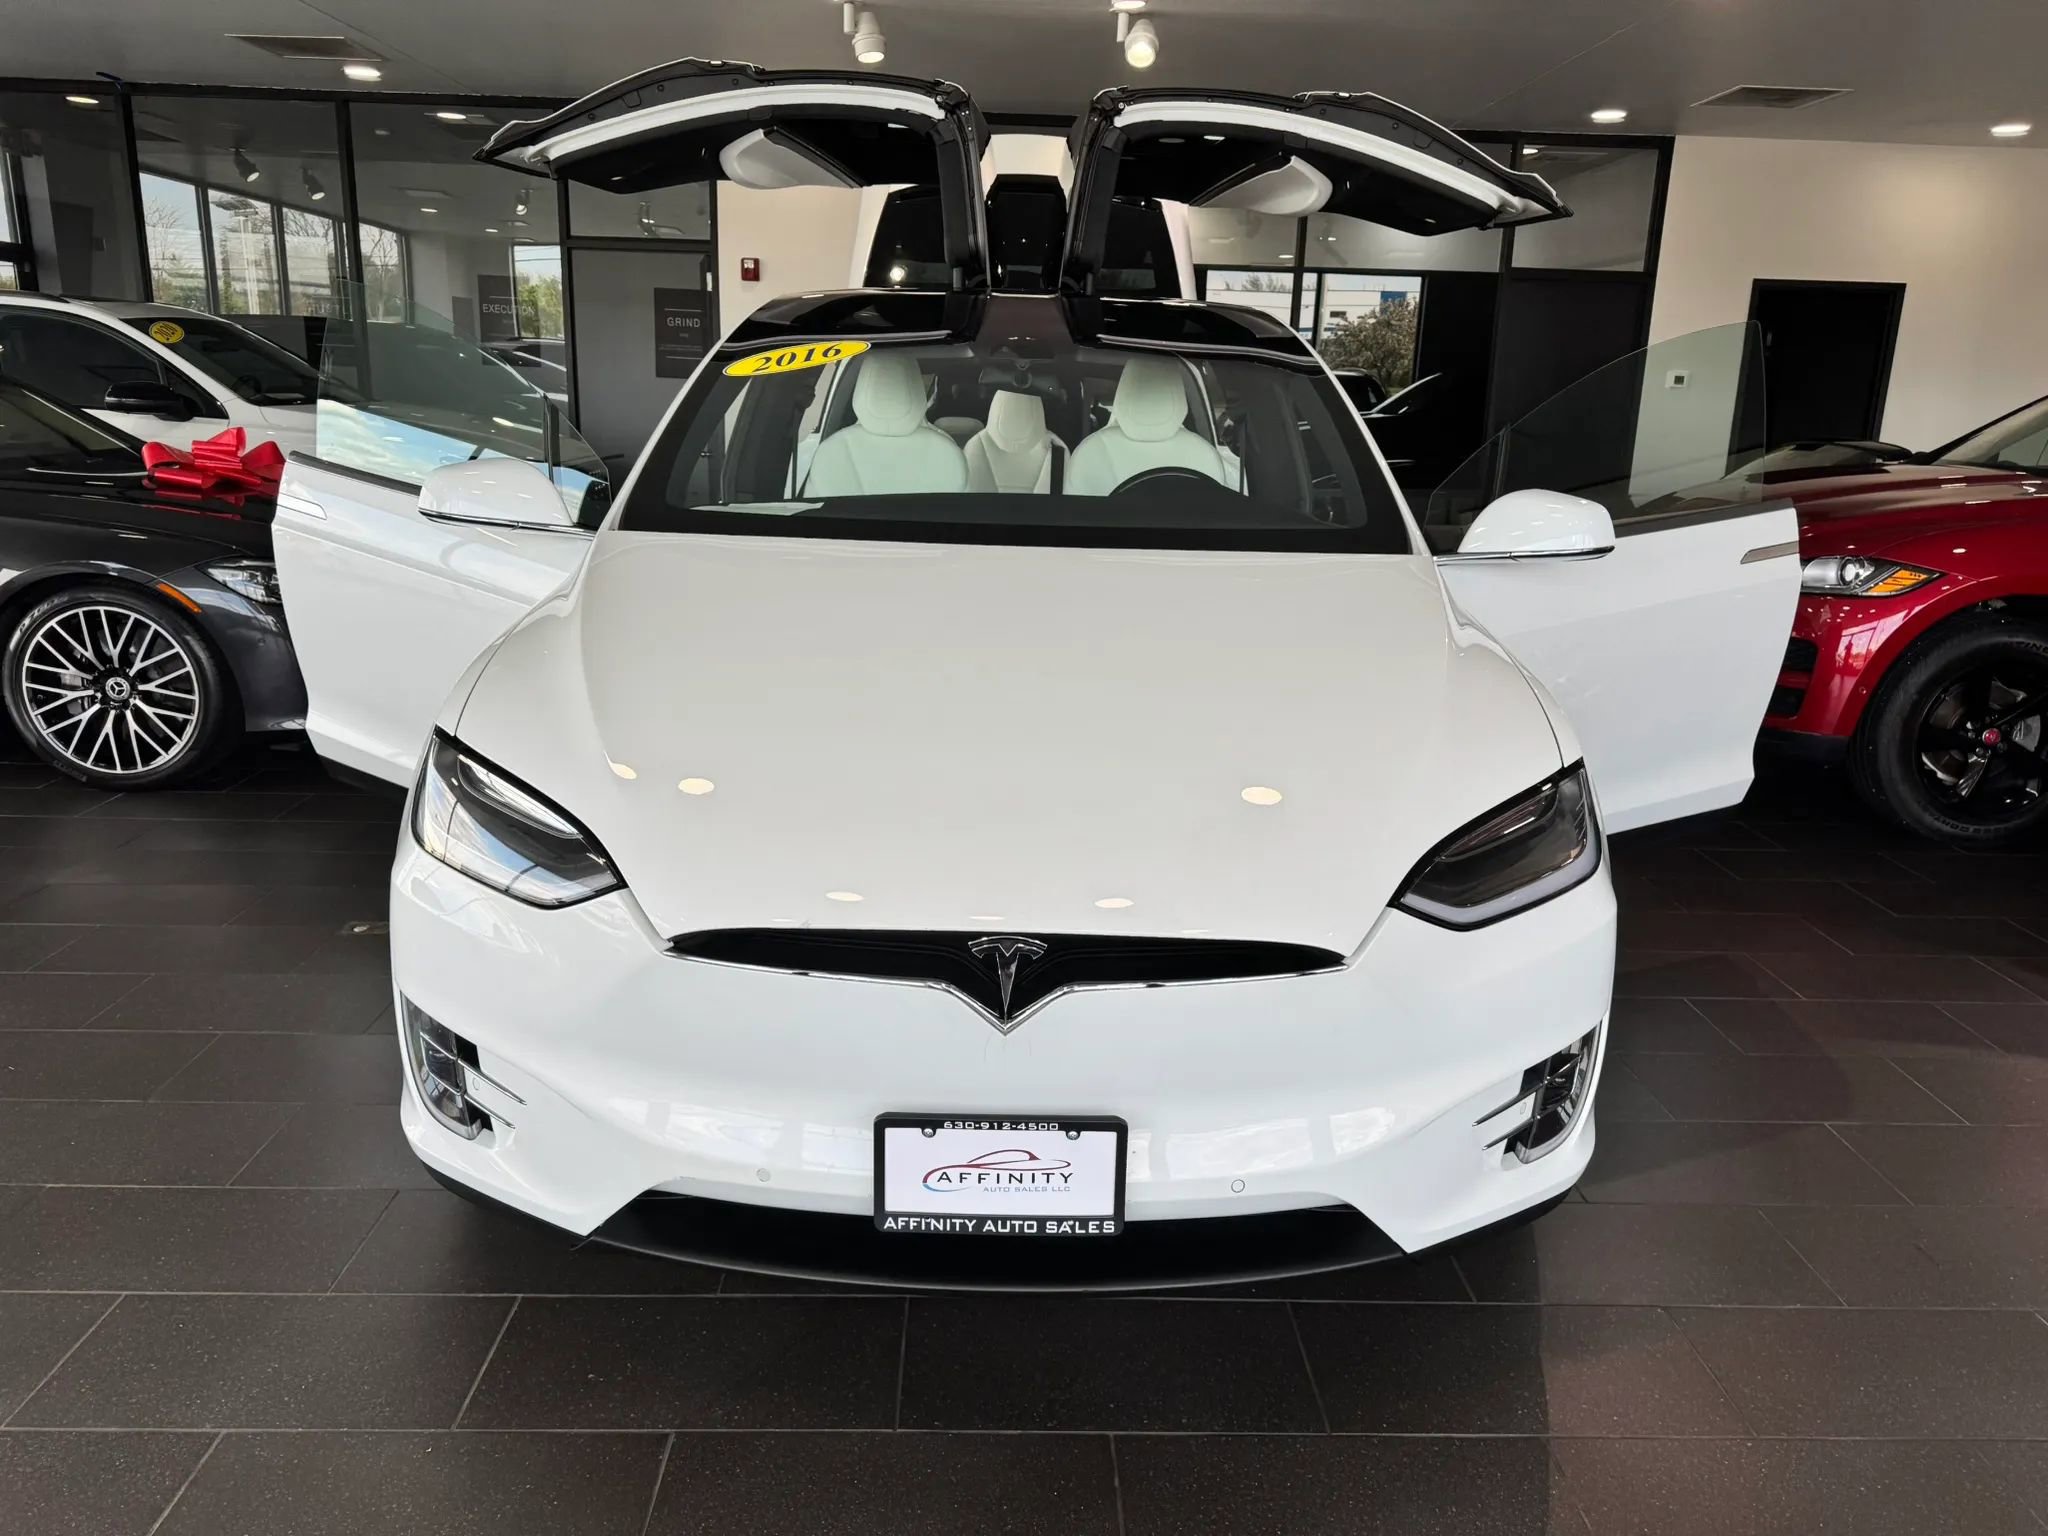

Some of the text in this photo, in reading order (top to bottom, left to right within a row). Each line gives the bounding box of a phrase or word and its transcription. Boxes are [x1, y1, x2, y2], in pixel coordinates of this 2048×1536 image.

[666, 316, 701, 328] GRIND
[752, 343, 842, 373] 2016
[943, 1121, 1059, 1131] 630-912-4500
[937, 1171, 1074, 1185] AFFINITY
[883, 1216, 1115, 1234] AFFINITY AUTO SALES
